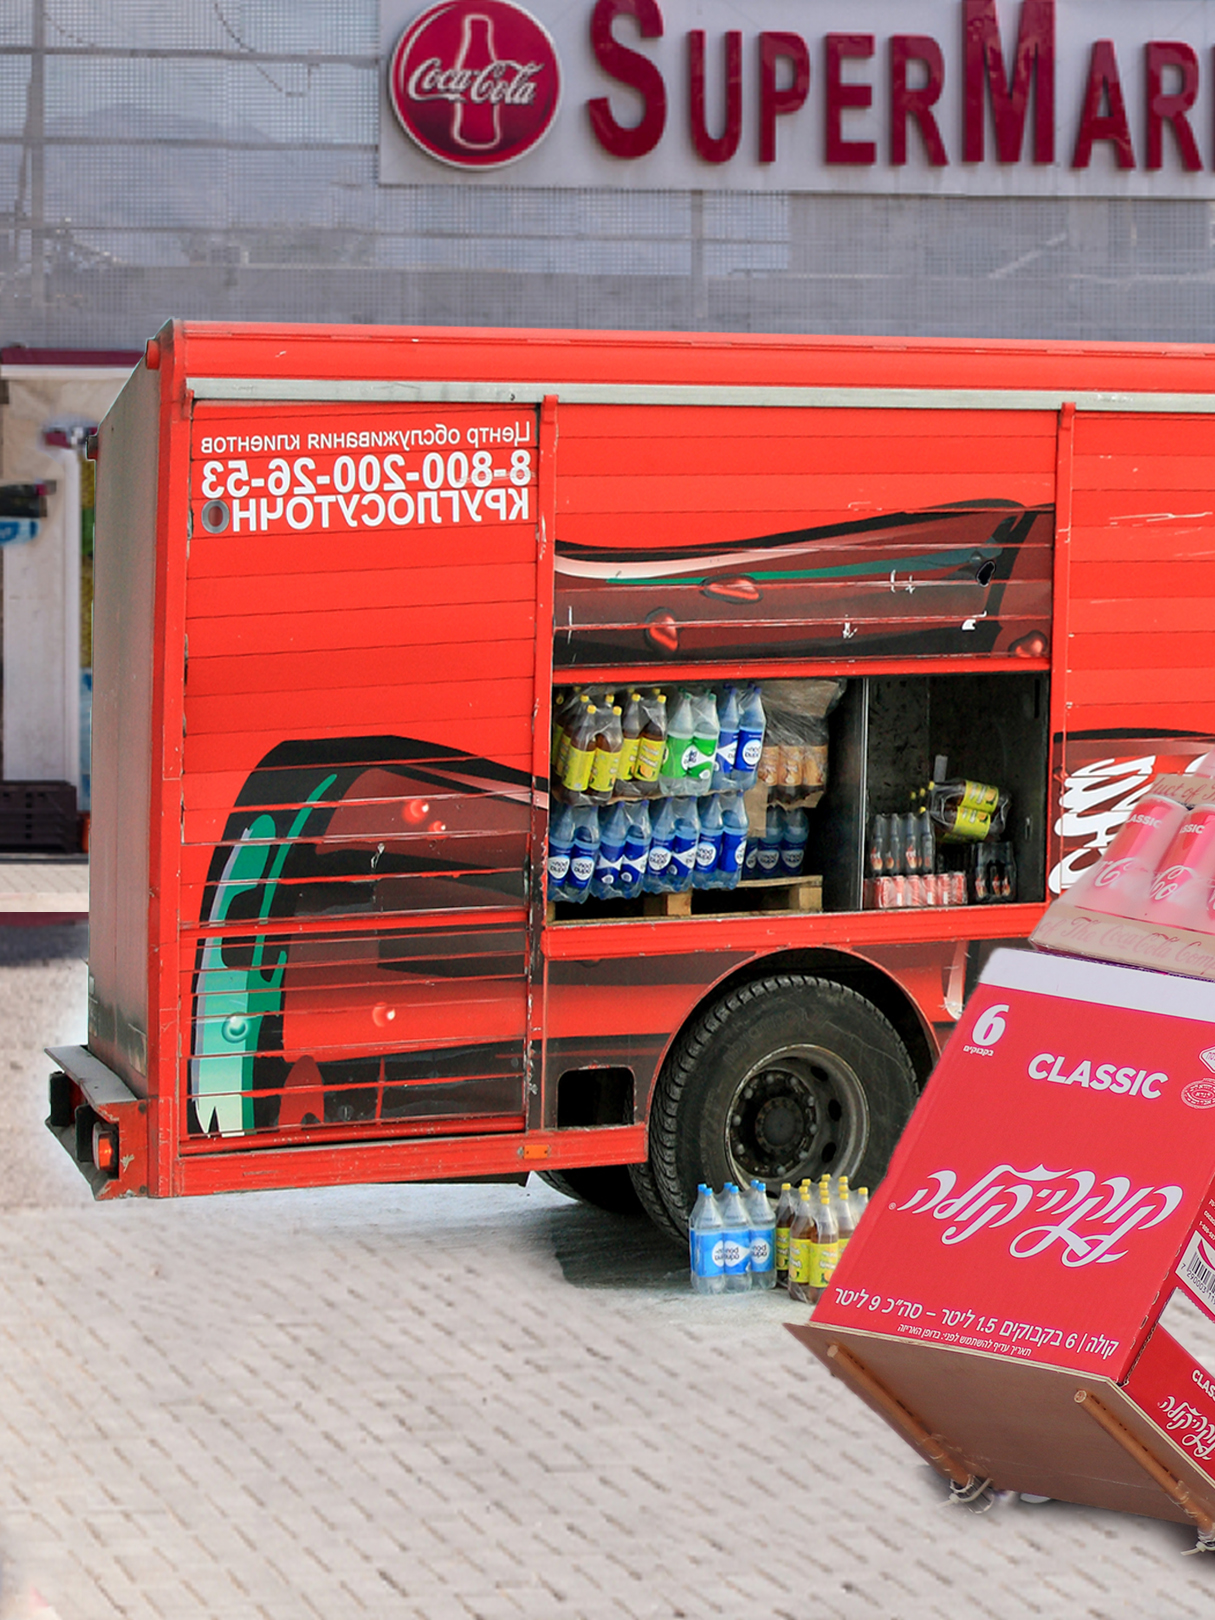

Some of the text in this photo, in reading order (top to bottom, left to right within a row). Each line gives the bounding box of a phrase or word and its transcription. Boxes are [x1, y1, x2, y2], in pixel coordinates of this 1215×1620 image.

[971, 1004, 1010, 1047] 6
[1027, 1053, 1169, 1100] CLASSIC
[835, 1287, 869, 1308] ליטר
[868, 1295, 881, 1311] 9
[941, 1308, 976, 1328] ליטר
[975, 1316, 998, 1334] 1.5
[999, 1321, 1063, 1349] בקבוקים
[1065, 1331, 1077, 1350] 6
[1085, 1334, 1120, 1360] קולה
